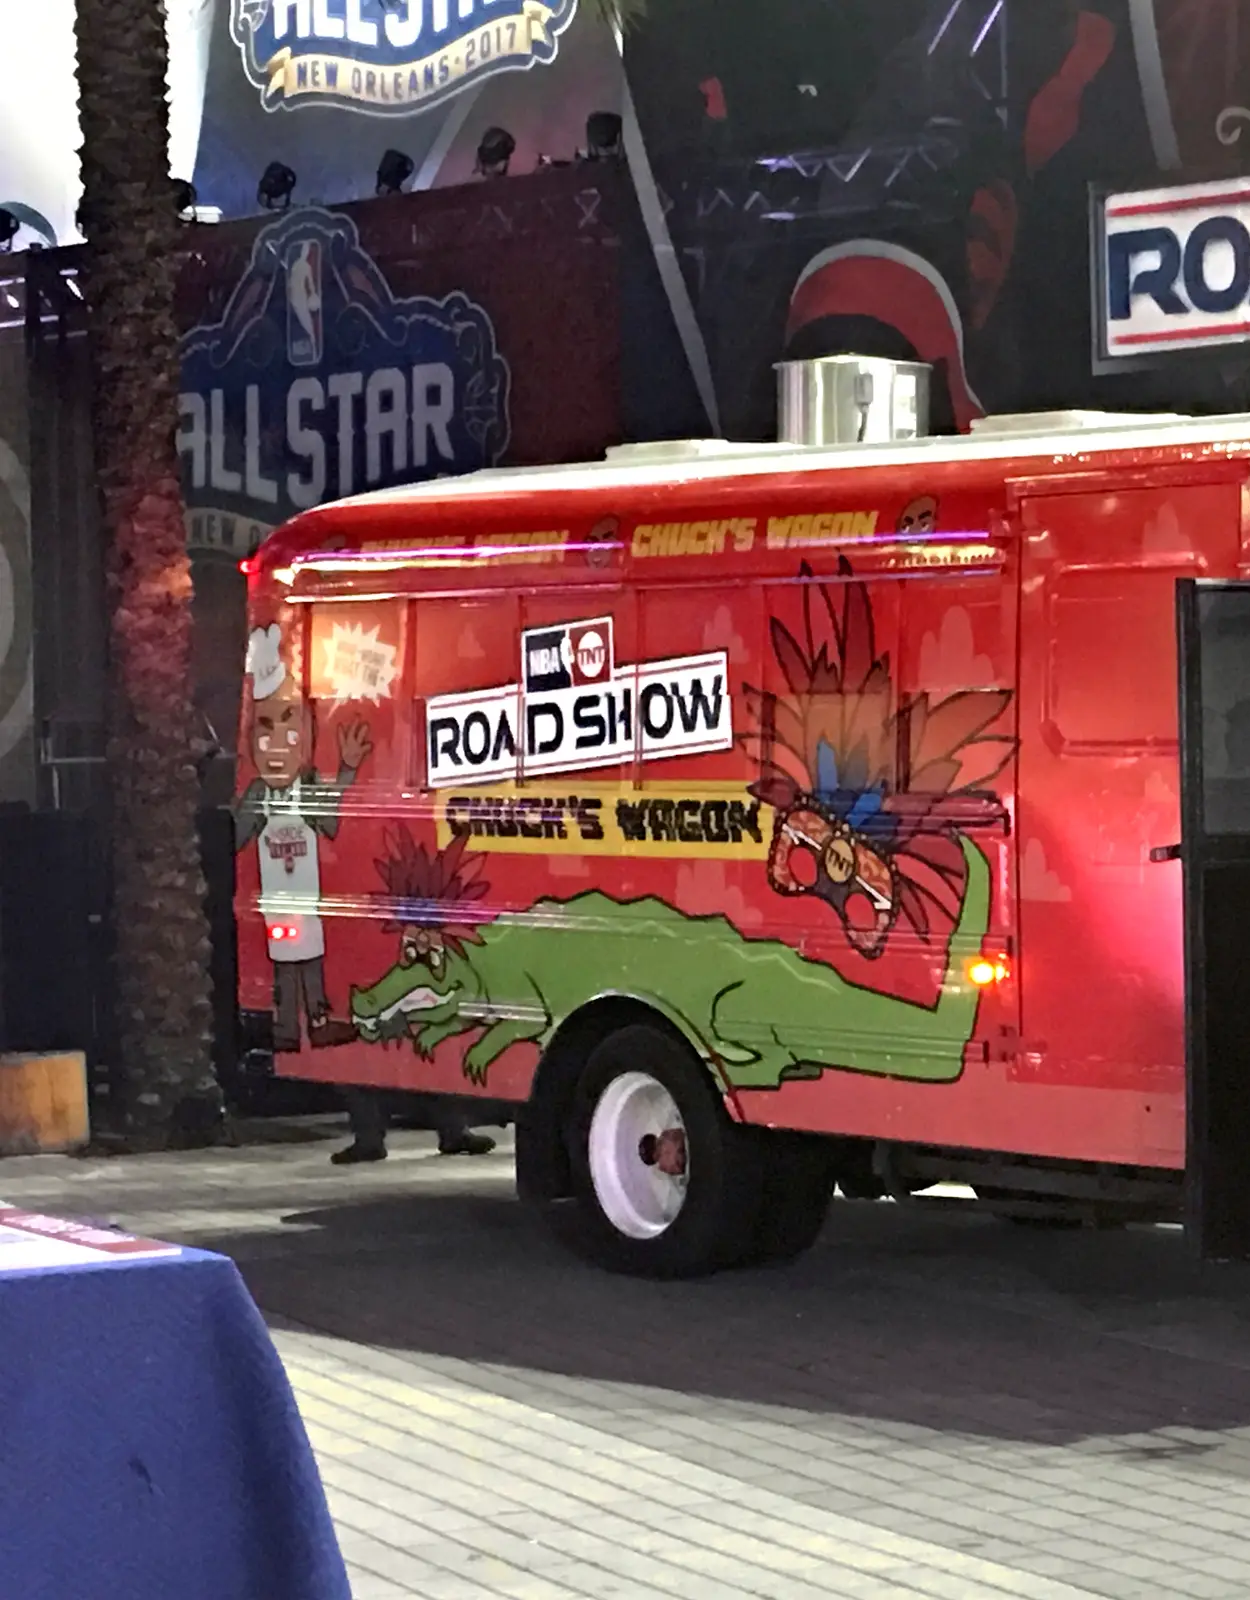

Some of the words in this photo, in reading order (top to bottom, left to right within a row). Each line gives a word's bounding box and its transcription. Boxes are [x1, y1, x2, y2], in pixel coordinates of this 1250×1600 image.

[296, 60, 338, 90] NEW
[351, 54, 449, 99] ORLEANS
[464, 21, 518, 66] 2017
[175, 384, 278, 503] ALL
[285, 362, 456, 508] STAR
[529, 646, 561, 677] NBA
[576, 647, 606, 667] TNT
[430, 702, 564, 769] ROAD
[573, 674, 723, 750] SHOW
[445, 794, 604, 840] CHUCK'S
[615, 797, 764, 844] WAGON
